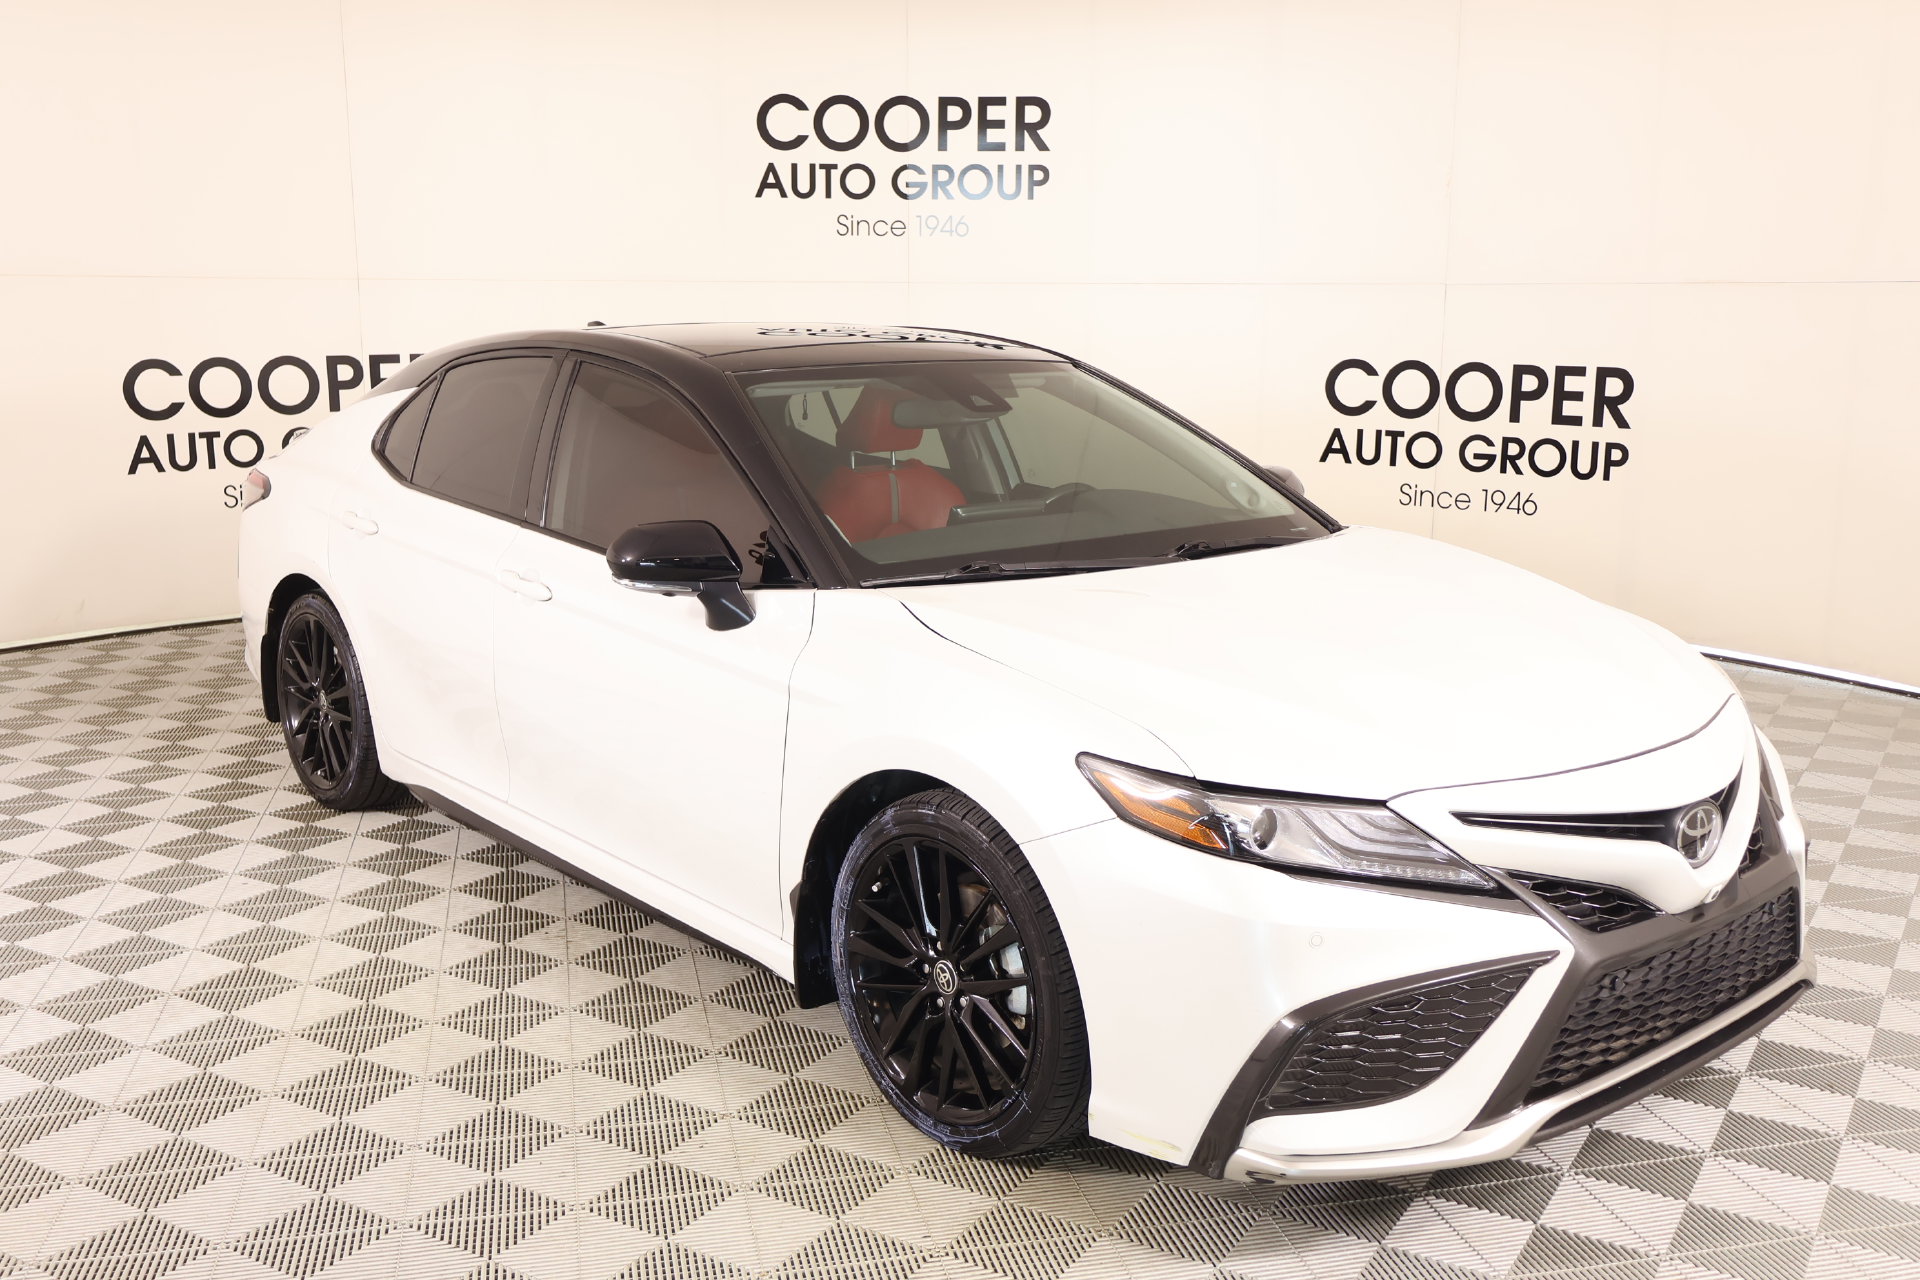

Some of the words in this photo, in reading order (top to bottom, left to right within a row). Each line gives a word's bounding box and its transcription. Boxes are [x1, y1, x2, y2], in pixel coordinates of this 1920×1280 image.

[756, 93, 1051, 152] COOPER
[755, 162, 876, 200] AUTO
[891, 163, 1050, 200] GROUP
[836, 214, 907, 237] Since
[915, 215, 970, 237] 1946
[122, 353, 425, 421] COOPE
[1325, 358, 1635, 429] COOPER
[127, 429, 264, 475] AUTO
[1319, 427, 1443, 469] AUTO
[1458, 434, 1629, 481] GROUP
[1399, 483, 1471, 510] Since
[1481, 489, 1538, 516] 1946
